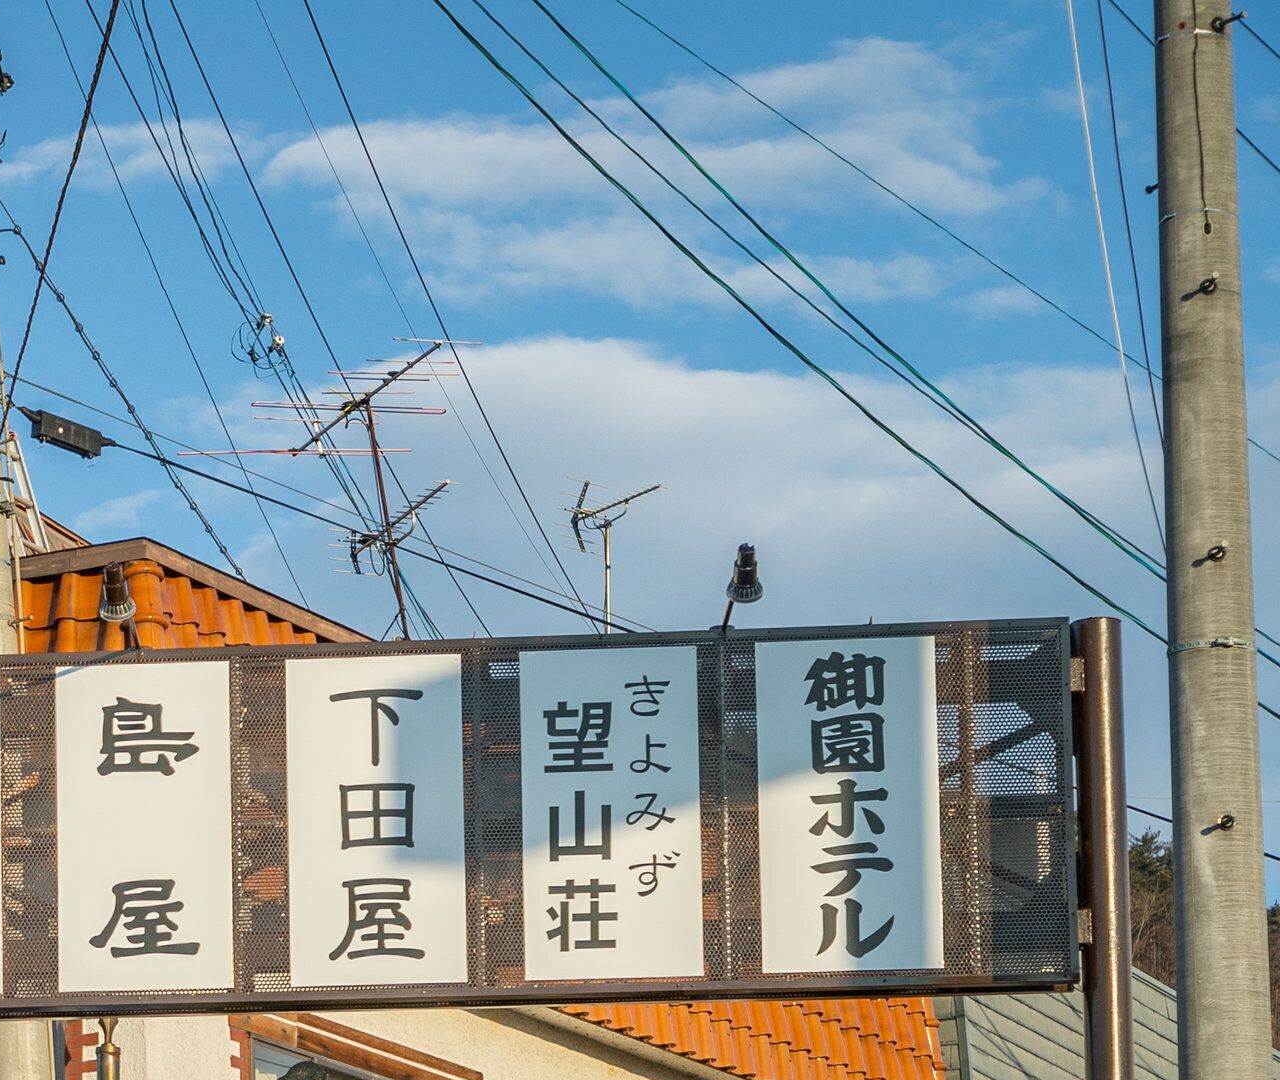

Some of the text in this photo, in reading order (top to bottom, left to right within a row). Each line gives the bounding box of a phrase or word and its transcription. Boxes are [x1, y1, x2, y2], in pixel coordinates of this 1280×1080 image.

[89, 696, 201, 959] 島屋
[328, 688, 426, 962] 下田屋
[543, 701, 619, 953] 望山荘
[624, 674, 681, 898] きよみず
[803, 651, 895, 959] 御園ホテル
